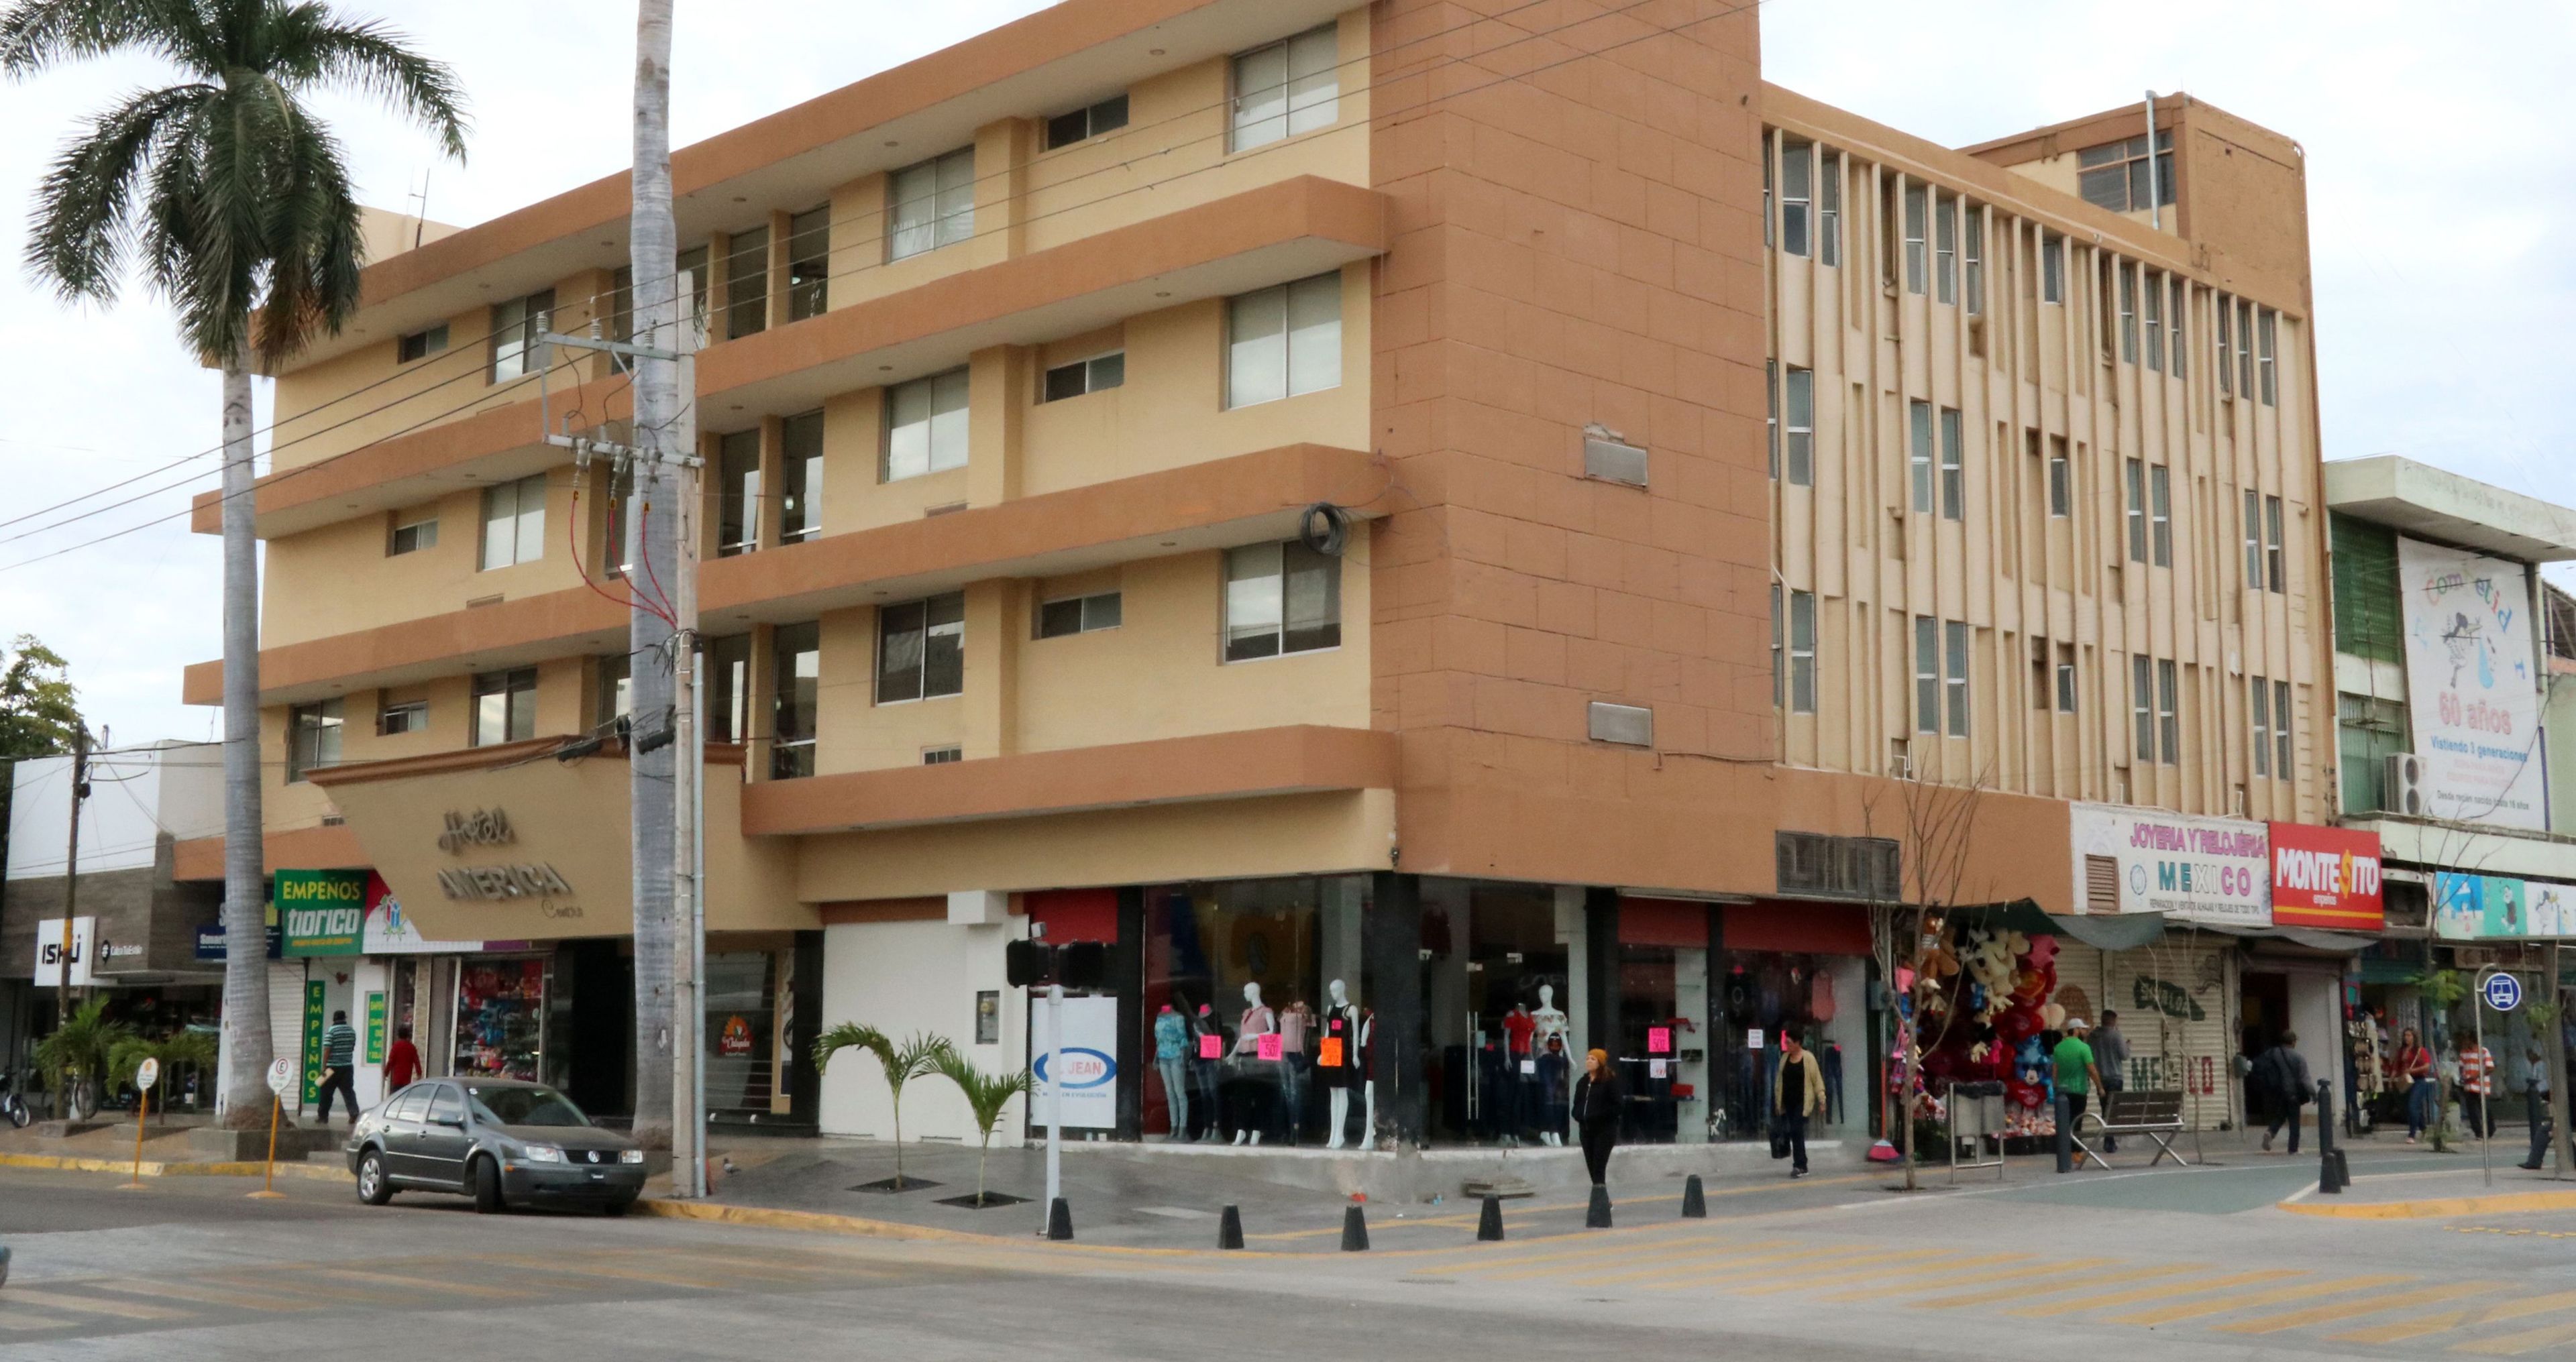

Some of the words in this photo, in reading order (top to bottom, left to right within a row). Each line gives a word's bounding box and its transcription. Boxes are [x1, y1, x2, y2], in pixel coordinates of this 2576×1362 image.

[2439, 691, 2461, 727] 60
[2467, 698, 2512, 735] años
[2431, 736, 2468, 754] Vistiendo
[2477, 746, 2528, 762] generaciones
[438, 806, 515, 856] Hotel
[2130, 822, 2186, 852] JOYERIA
[2158, 861, 2251, 897] MEXICO
[1069, 1062, 1101, 1075] JEAN
